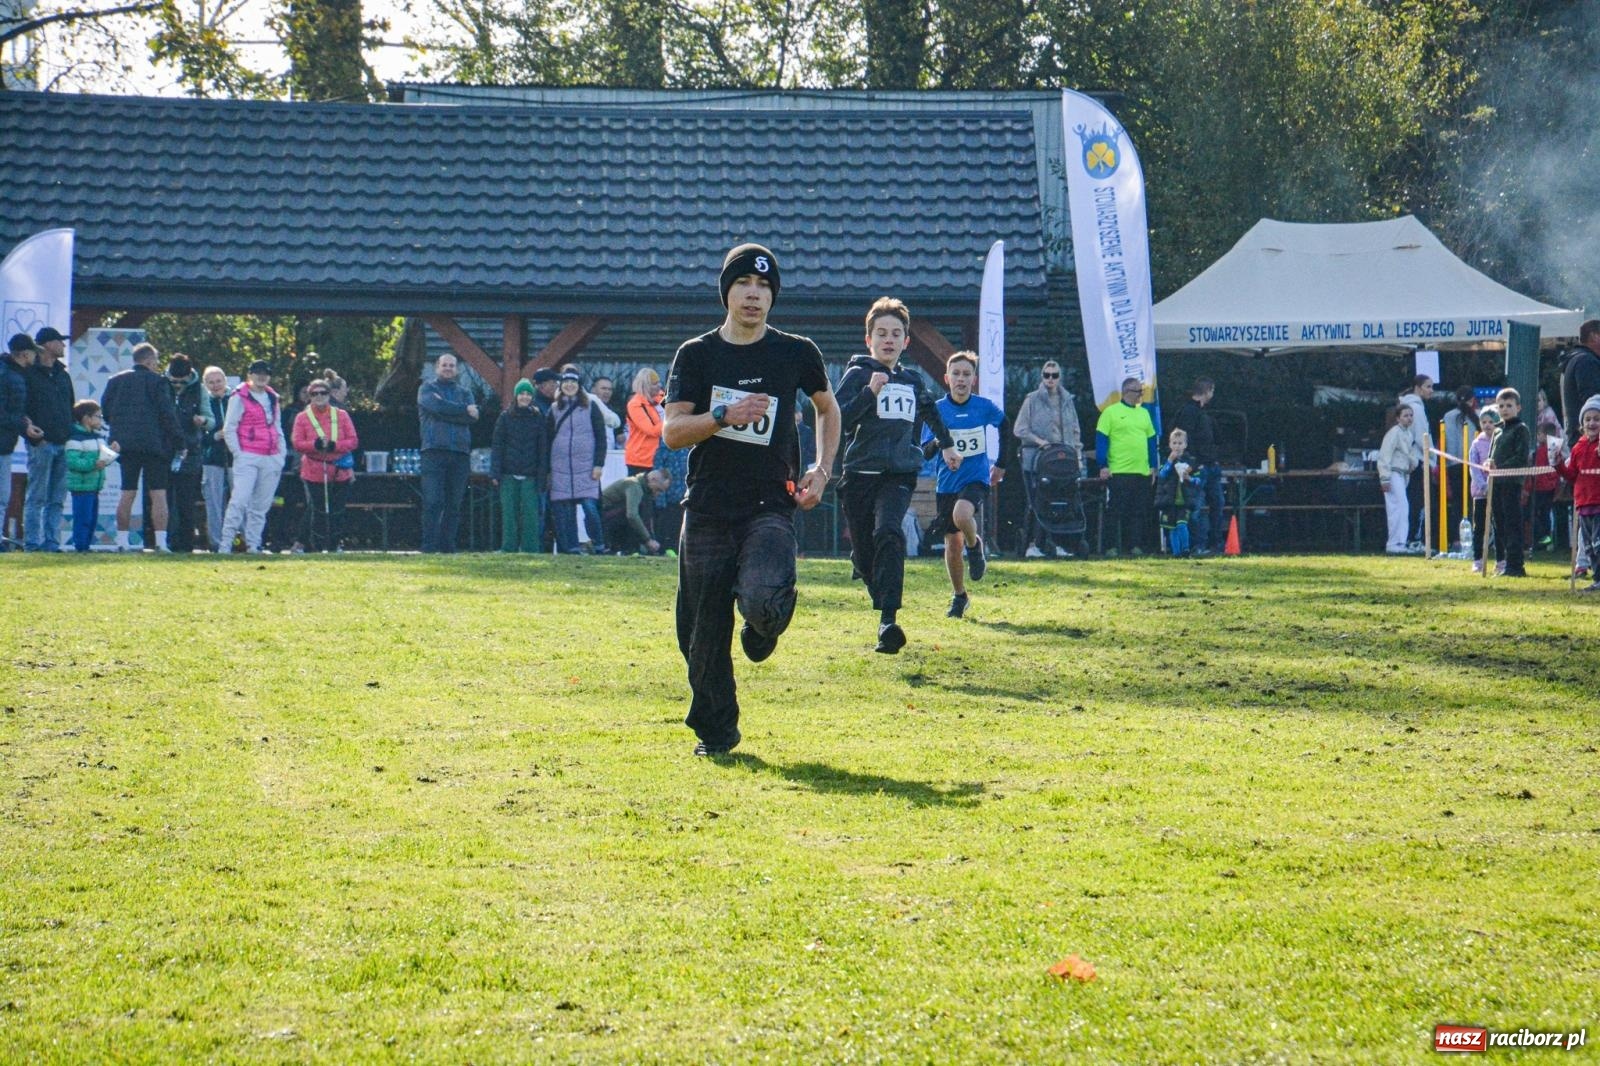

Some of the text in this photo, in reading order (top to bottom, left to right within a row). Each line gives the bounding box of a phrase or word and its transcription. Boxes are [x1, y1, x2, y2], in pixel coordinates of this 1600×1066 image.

[1094, 186, 1123, 259] STOWARZYSZENIE
[1103, 261, 1129, 298] AKTYWNI
[1111, 298, 1134, 318] DLA
[1115, 318, 1140, 361] LEPSZEGO
[1189, 319, 1503, 343] STOWARZYSZENIE AKTYWNI DLA LEPSZEGO JUTRA
[880, 396, 914, 414] 117
[956, 438, 979, 452] 93
